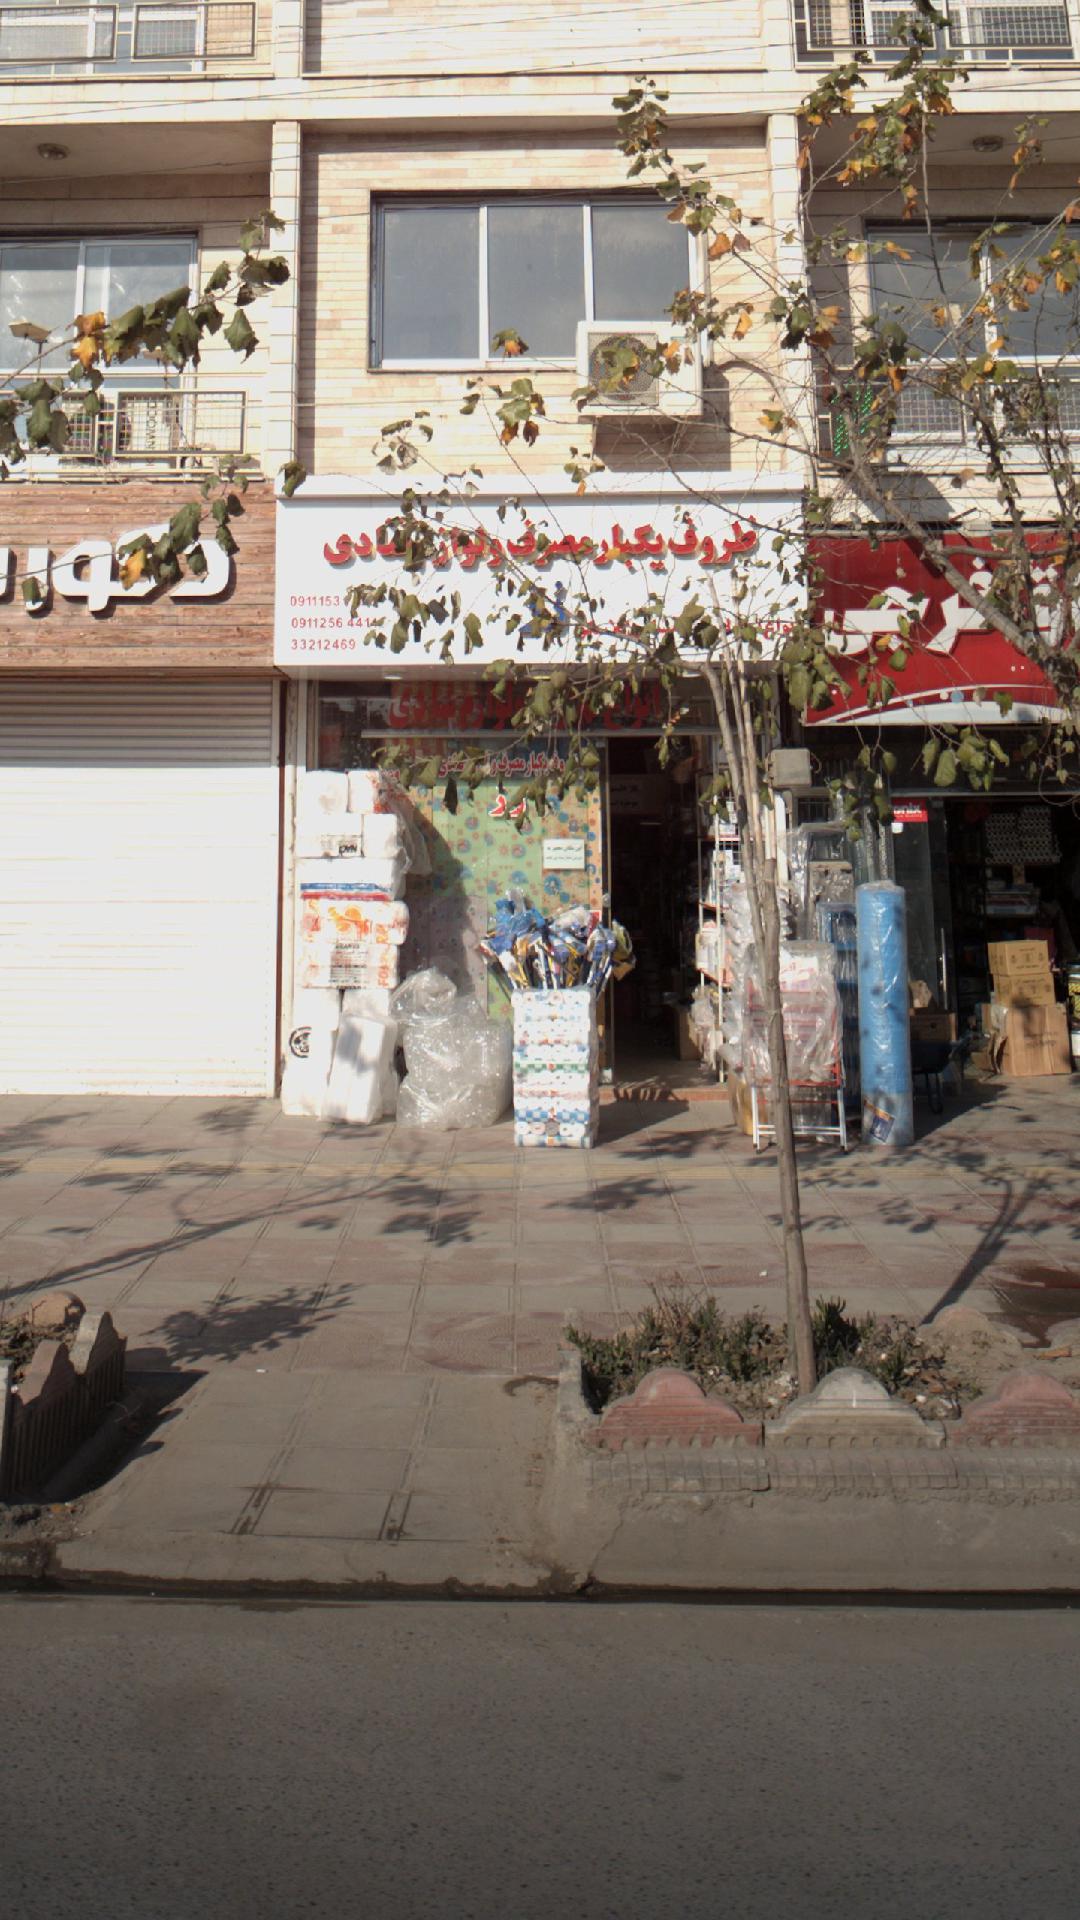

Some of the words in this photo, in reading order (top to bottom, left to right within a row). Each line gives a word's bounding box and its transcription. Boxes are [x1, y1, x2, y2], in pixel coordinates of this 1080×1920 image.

[593, 522, 665, 570] یکبار
[668, 514, 758, 565] ظروف
[290, 595, 340, 607] 0911153
[291, 638, 356, 650] 33212469
